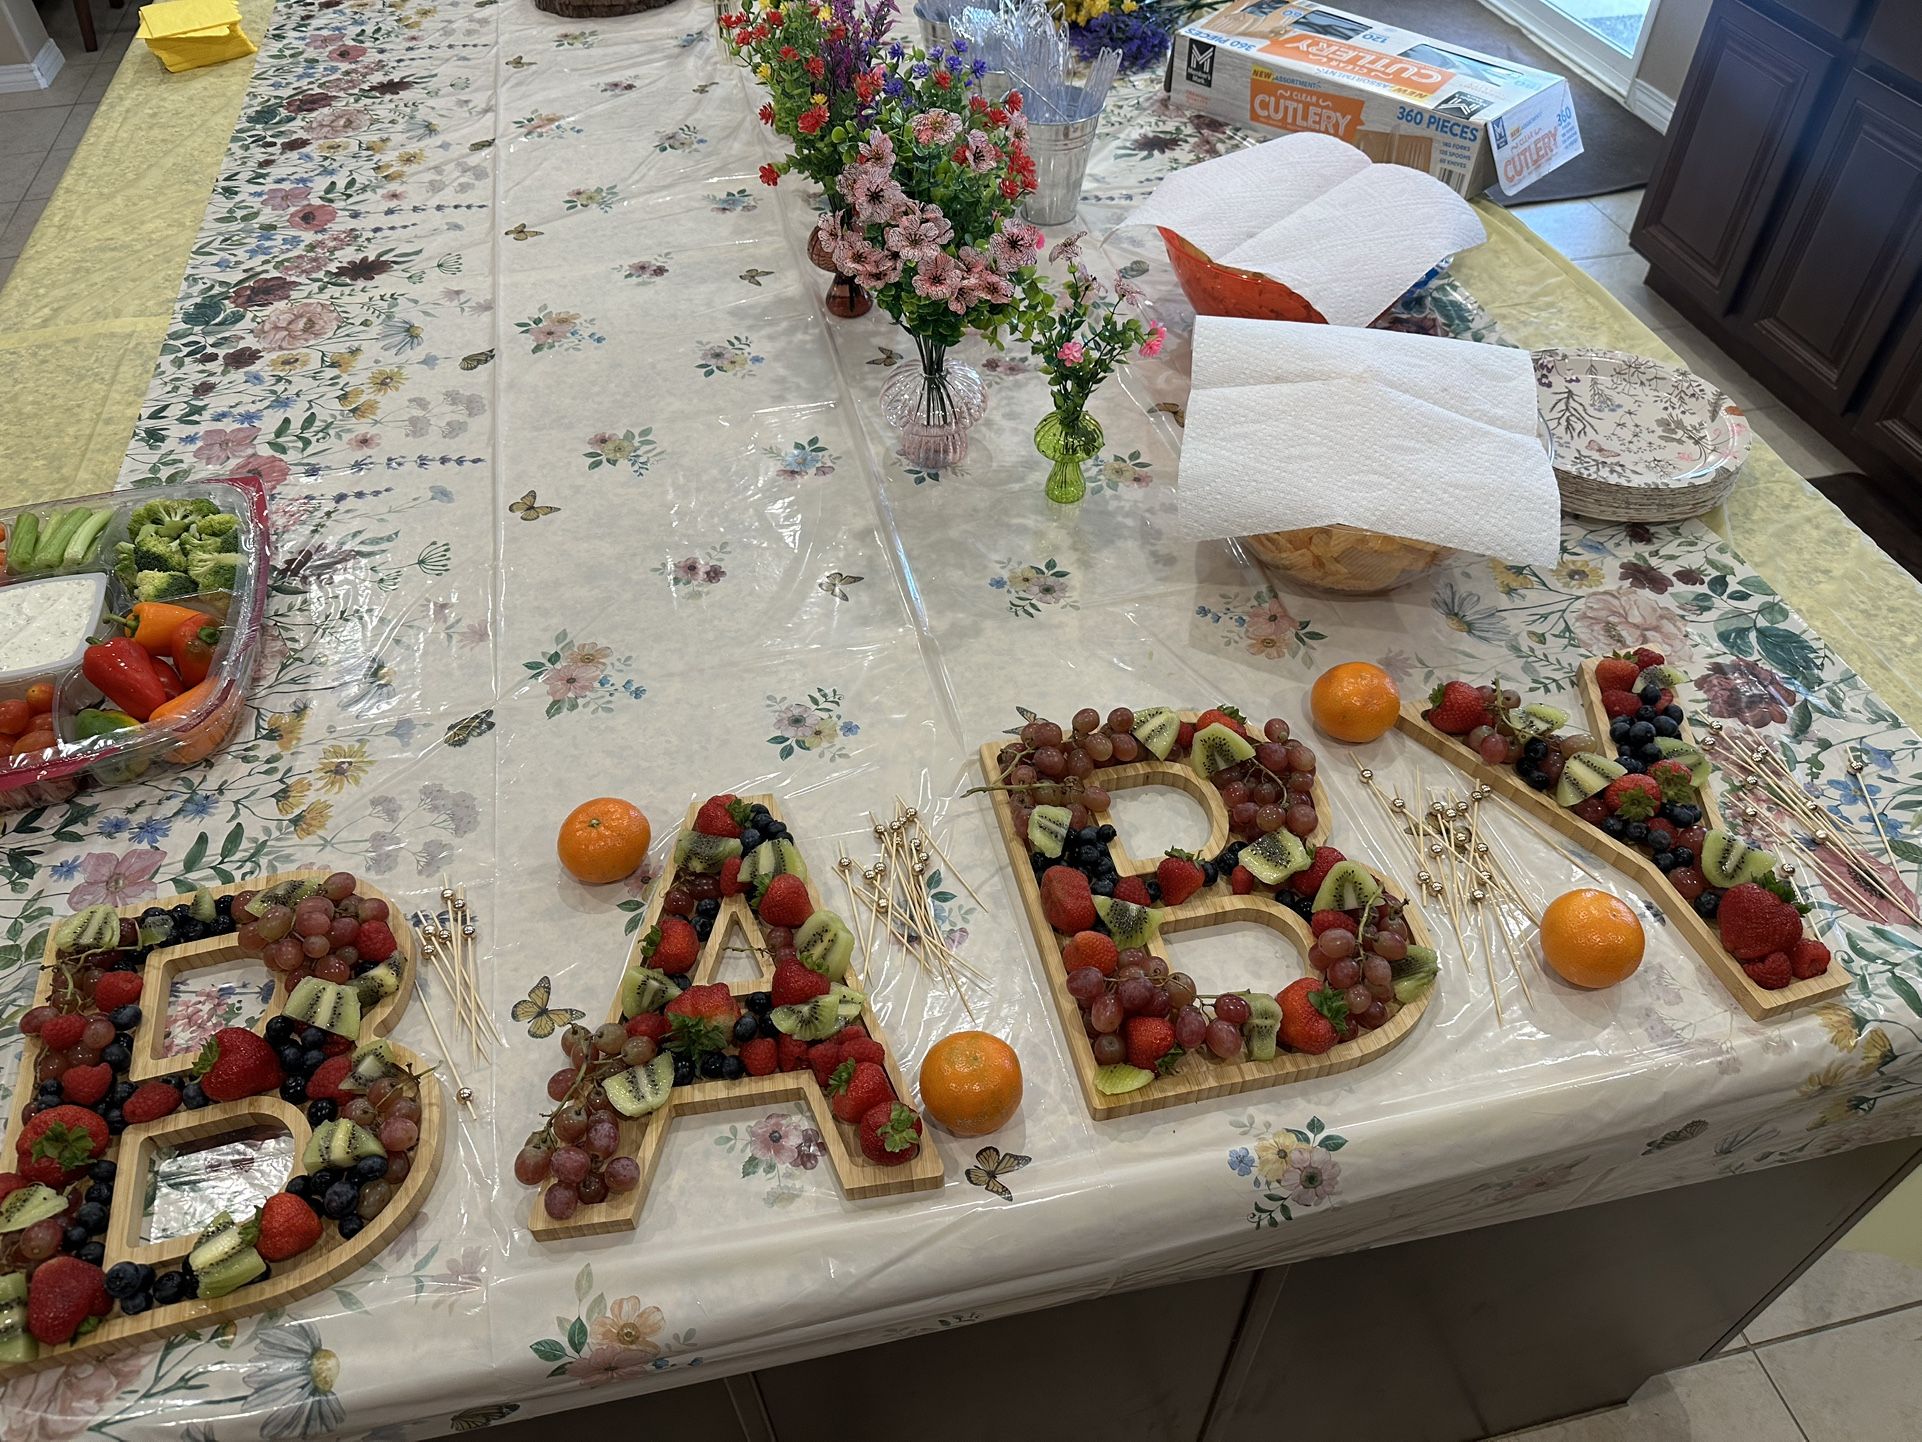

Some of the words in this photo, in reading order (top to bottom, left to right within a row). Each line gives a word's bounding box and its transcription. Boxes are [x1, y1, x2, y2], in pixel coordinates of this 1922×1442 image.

[1185, 27, 1230, 44] PIECES
[1362, 33, 1391, 44] 120
[1230, 40, 1257, 52] 360
[1284, 39, 1442, 84] CUTLERY
[1329, 60, 1369, 74] CLEAR
[1252, 69, 1272, 80] NEW
[1292, 91, 1317, 104] CLEAR
[1393, 86, 1428, 99] NEW
[1253, 93, 1352, 137] CUTLERY
[1556, 106, 1572, 127] 360
[1396, 105, 1424, 126] 360
[1426, 114, 1479, 143] PIECES
[1503, 126, 1559, 183] CUTLERY
